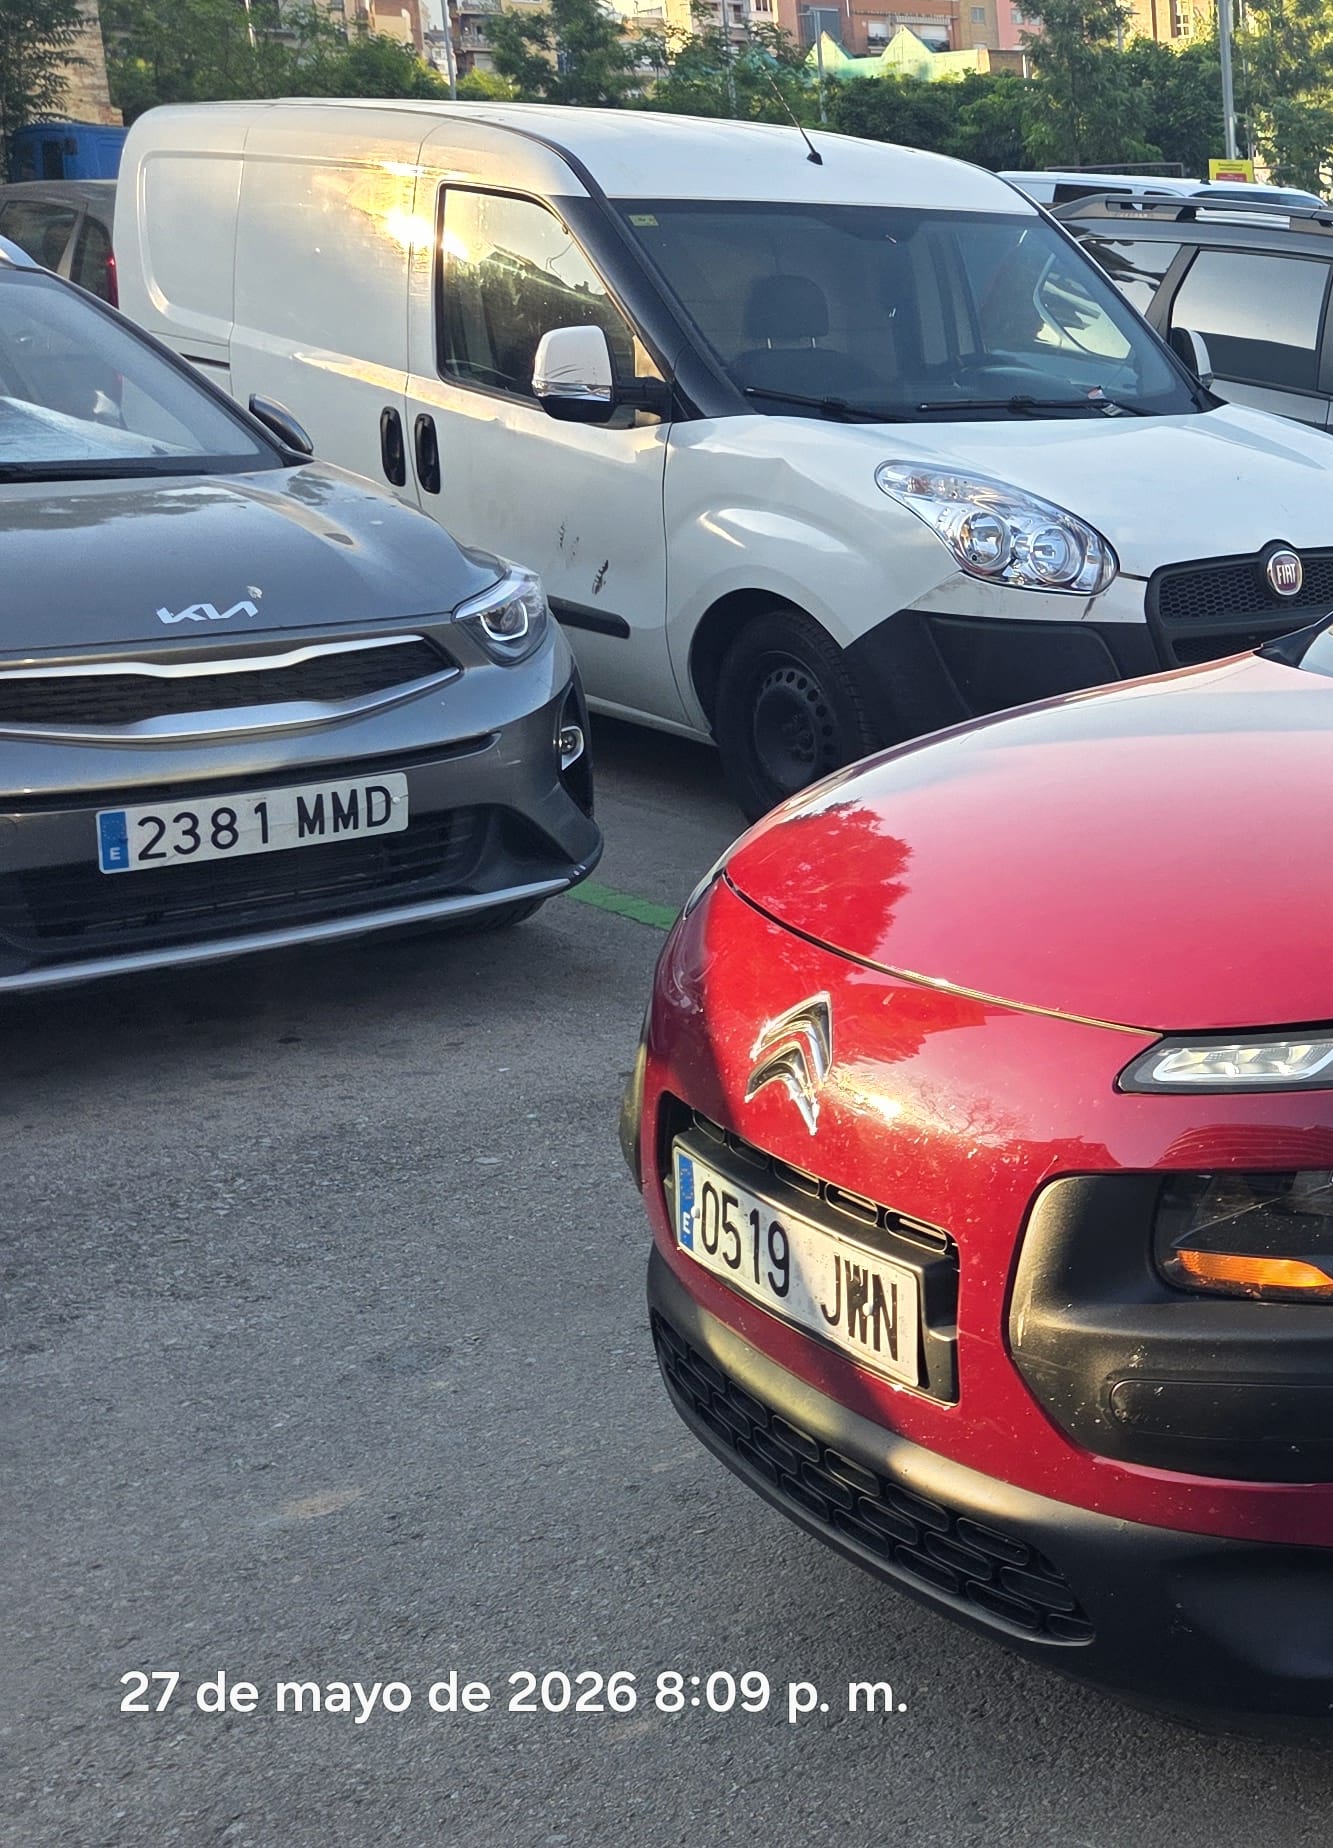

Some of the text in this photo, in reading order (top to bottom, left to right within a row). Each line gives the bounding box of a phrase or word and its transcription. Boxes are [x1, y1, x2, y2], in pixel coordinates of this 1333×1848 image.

[1276, 563, 1296, 585] FIAT
[137, 802, 270, 862] 2381
[297, 785, 392, 838] MMD
[701, 1180, 791, 1298] 0519
[820, 1254, 899, 1362] JWN
